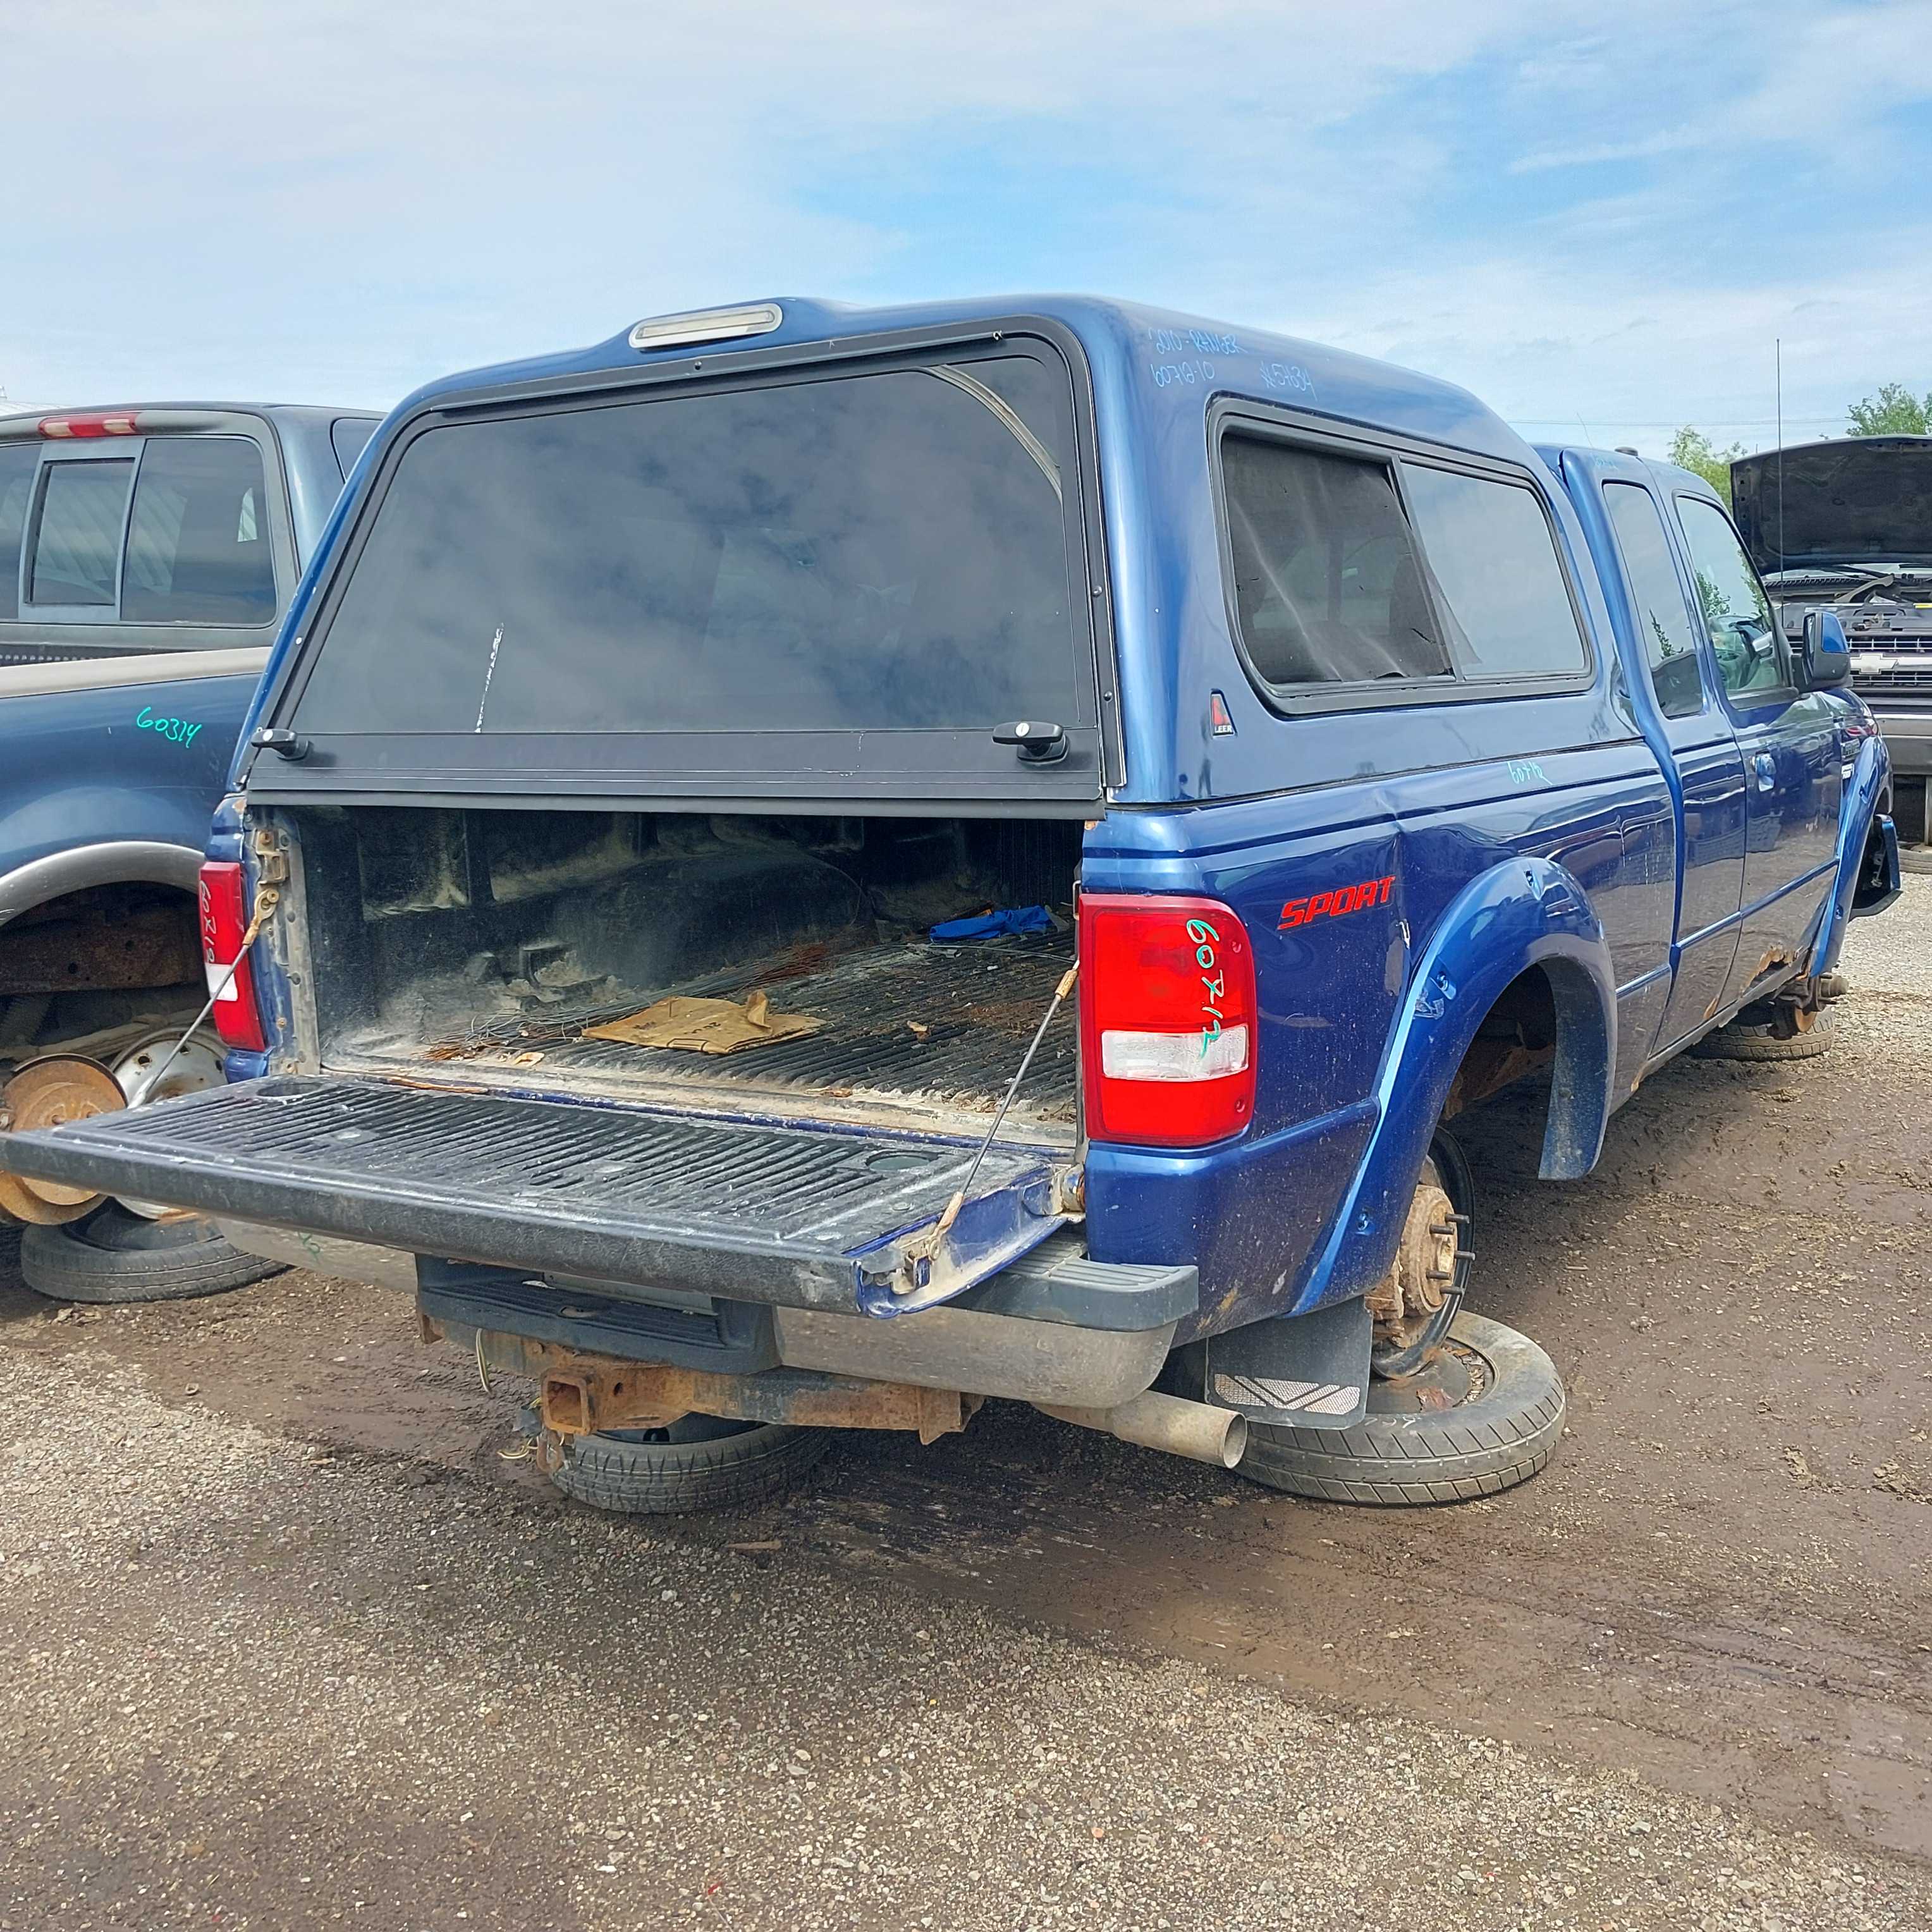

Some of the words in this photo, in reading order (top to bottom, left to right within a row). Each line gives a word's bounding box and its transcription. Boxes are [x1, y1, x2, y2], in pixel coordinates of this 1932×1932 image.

[137, 706, 202, 749] 60314
[1214, 725, 1232, 733] LEER
[1278, 876, 1396, 930] SPORT
